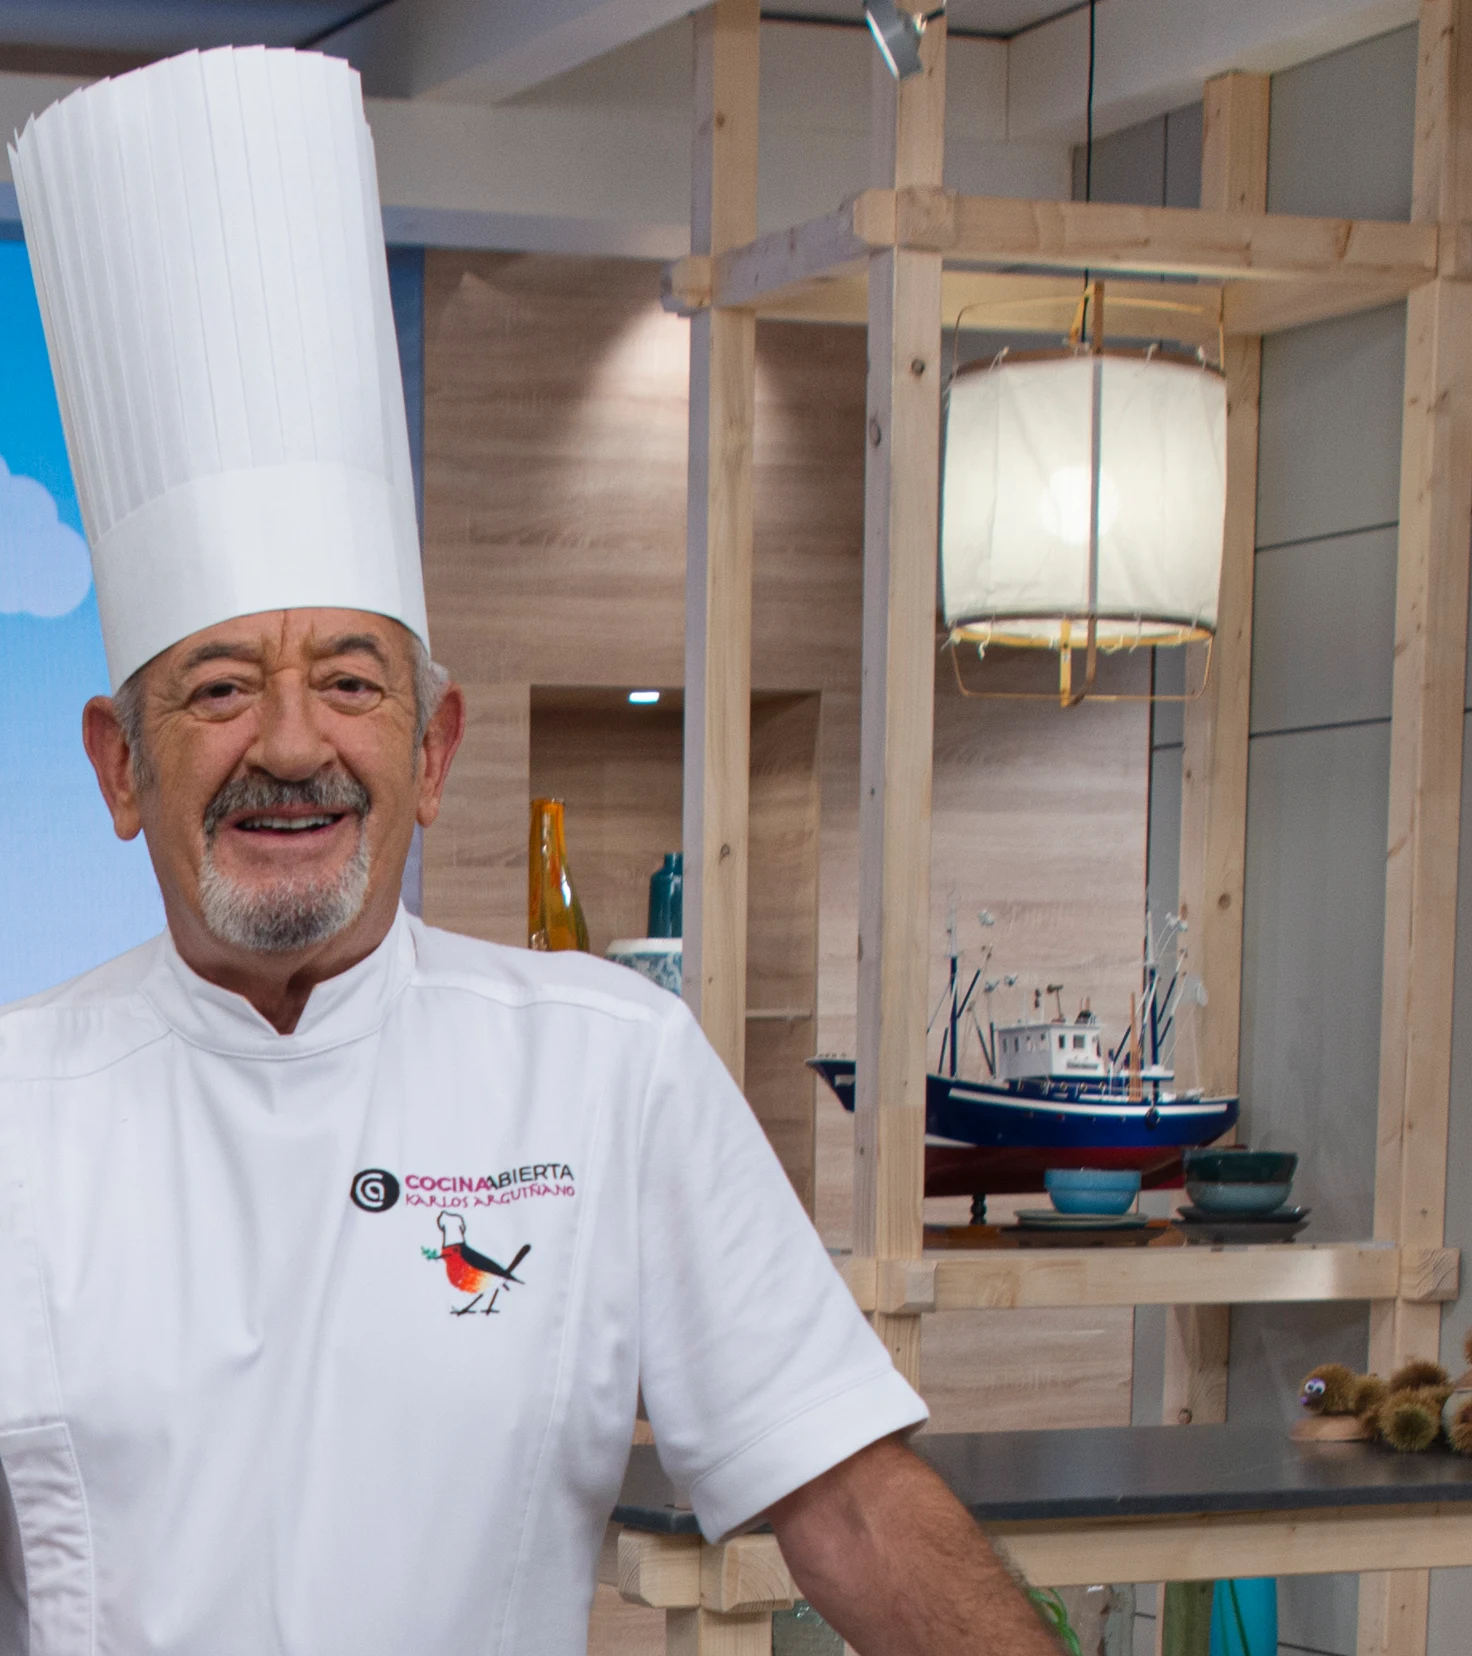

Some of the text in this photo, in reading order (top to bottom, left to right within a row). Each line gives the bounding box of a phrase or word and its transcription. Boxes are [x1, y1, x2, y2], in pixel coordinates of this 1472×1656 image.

[405, 1163, 574, 1193] COCINA ABIERTA
[406, 1181, 575, 1208] KARLOS ARGUIÑANO
